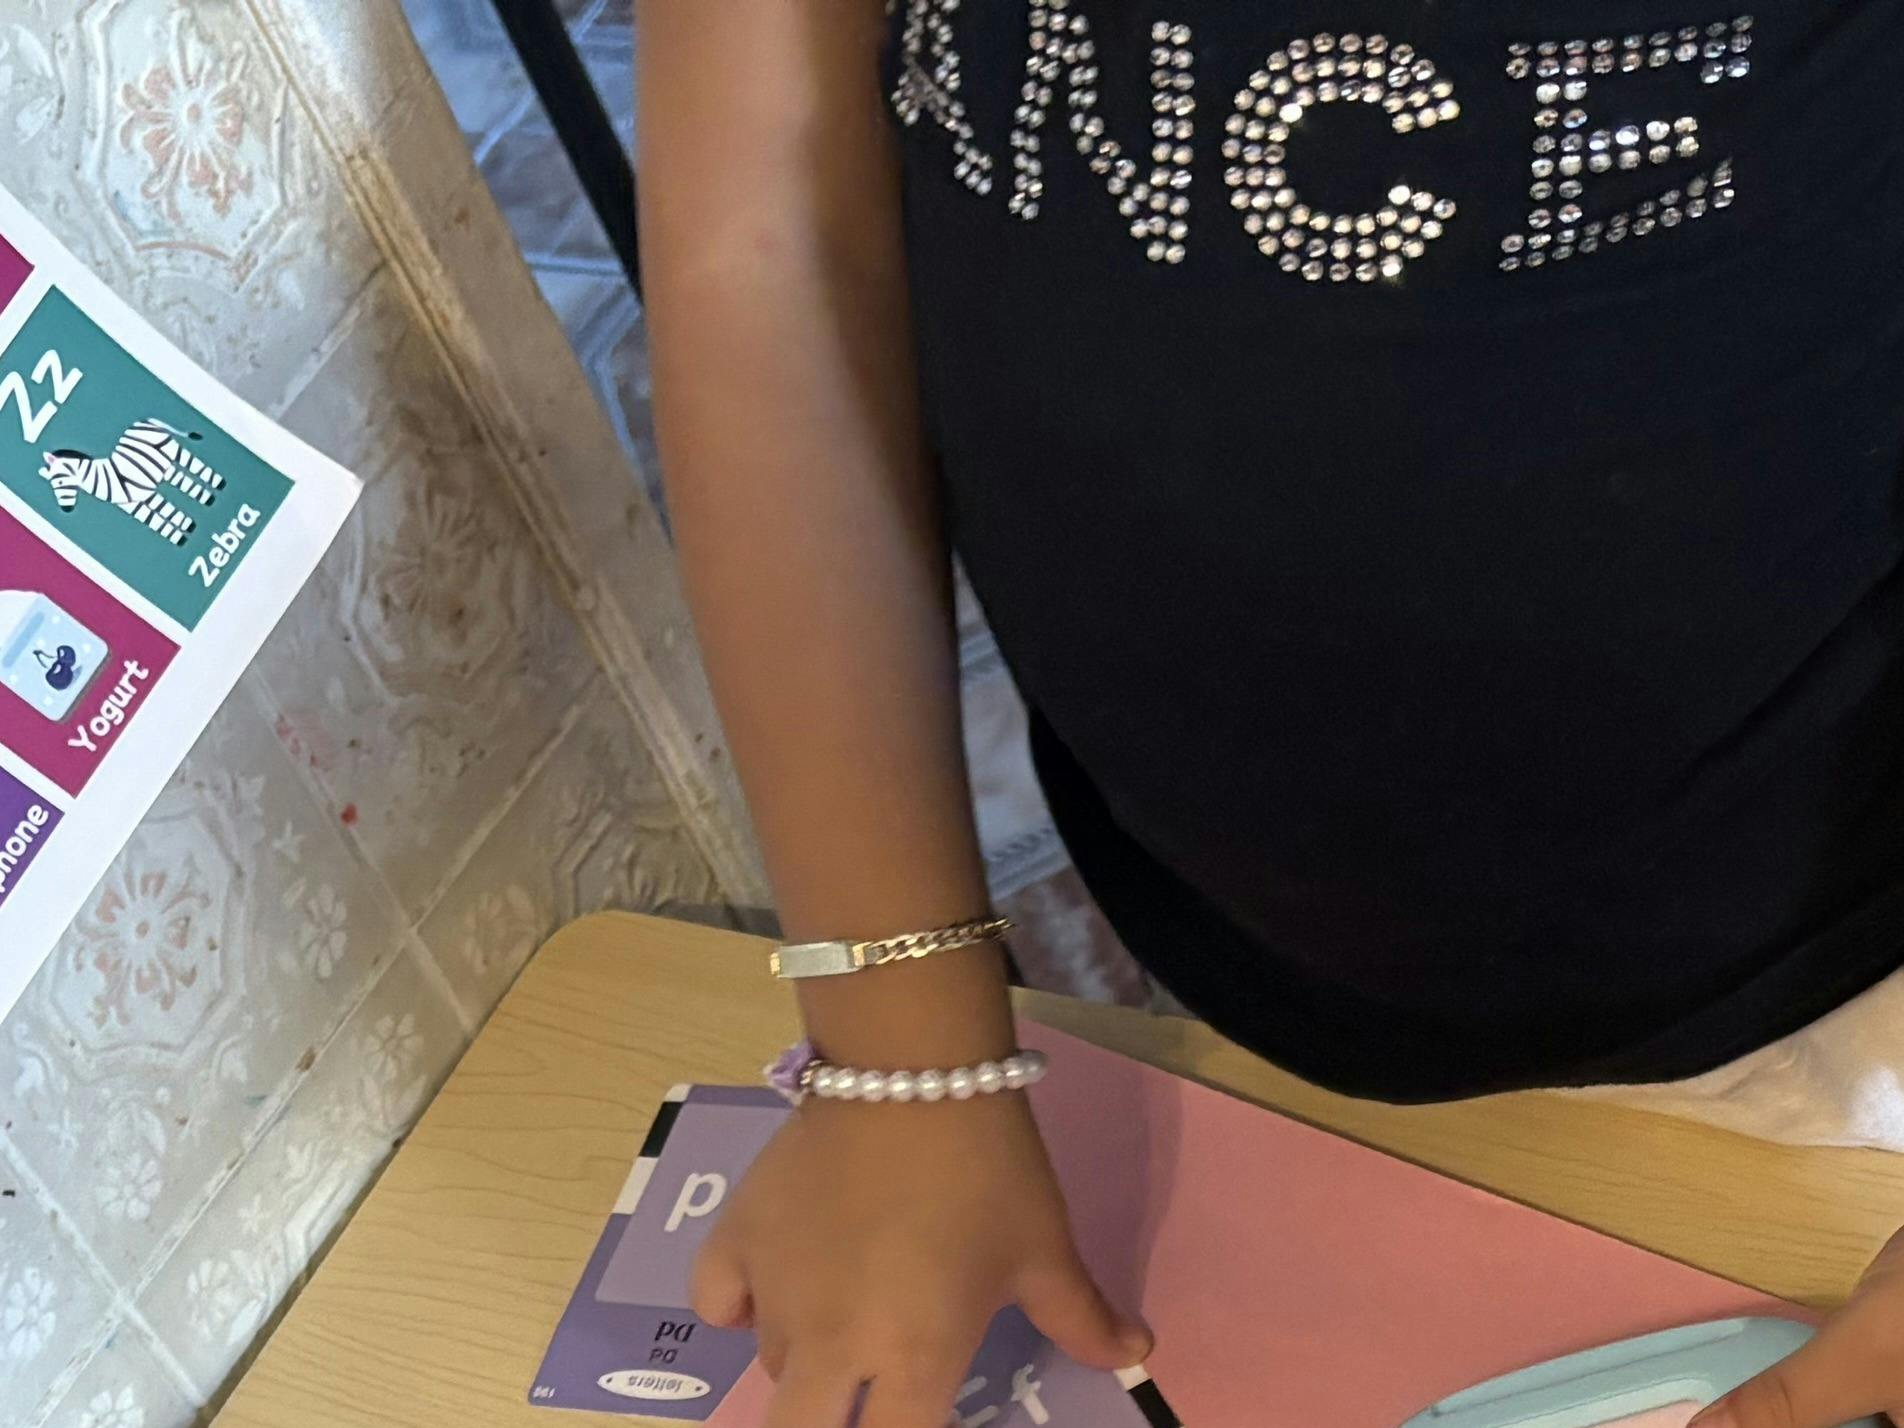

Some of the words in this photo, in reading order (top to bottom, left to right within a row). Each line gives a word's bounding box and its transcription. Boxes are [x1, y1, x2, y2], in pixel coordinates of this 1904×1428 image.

[189, 504, 260, 587] Zebra
[68, 661, 148, 751] Yogurt
[663, 1171, 728, 1232] d
[627, 1374, 684, 1394] letters
